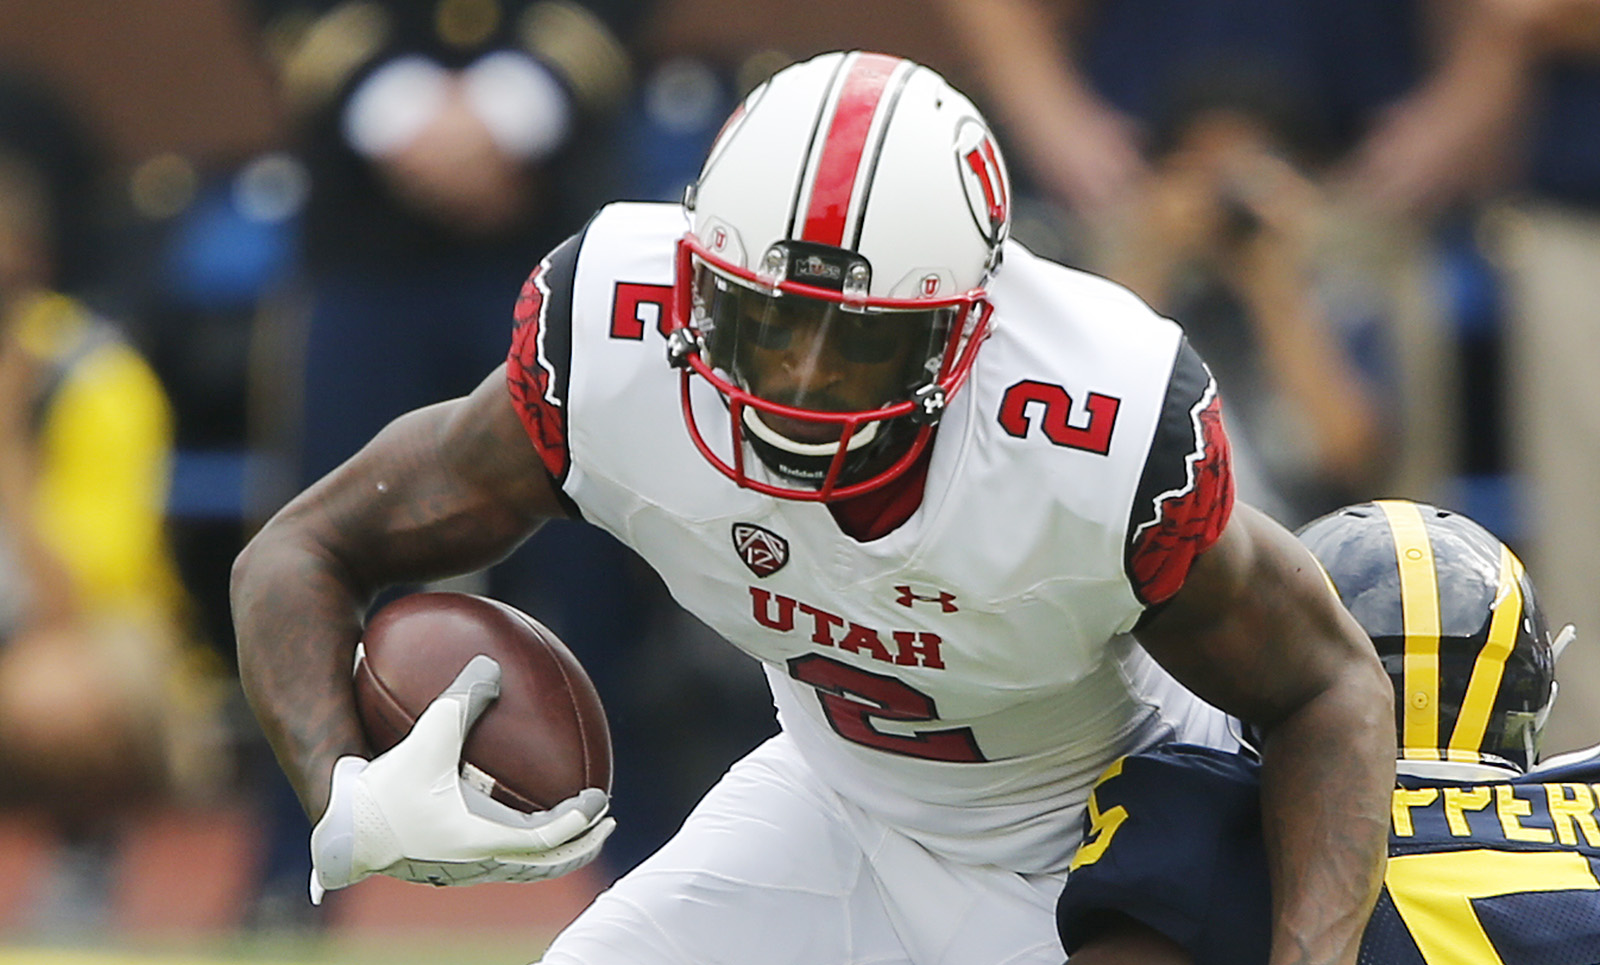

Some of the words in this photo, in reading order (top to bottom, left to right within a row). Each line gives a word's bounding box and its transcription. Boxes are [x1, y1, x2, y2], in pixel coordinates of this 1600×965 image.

[966, 136, 1006, 223] U
[923, 278, 940, 295] U
[996, 379, 1121, 456] 2
[733, 526, 785, 564] PAC
[747, 546, 774, 570] 12
[749, 585, 946, 670] UTAH
[786, 652, 989, 763] 2
